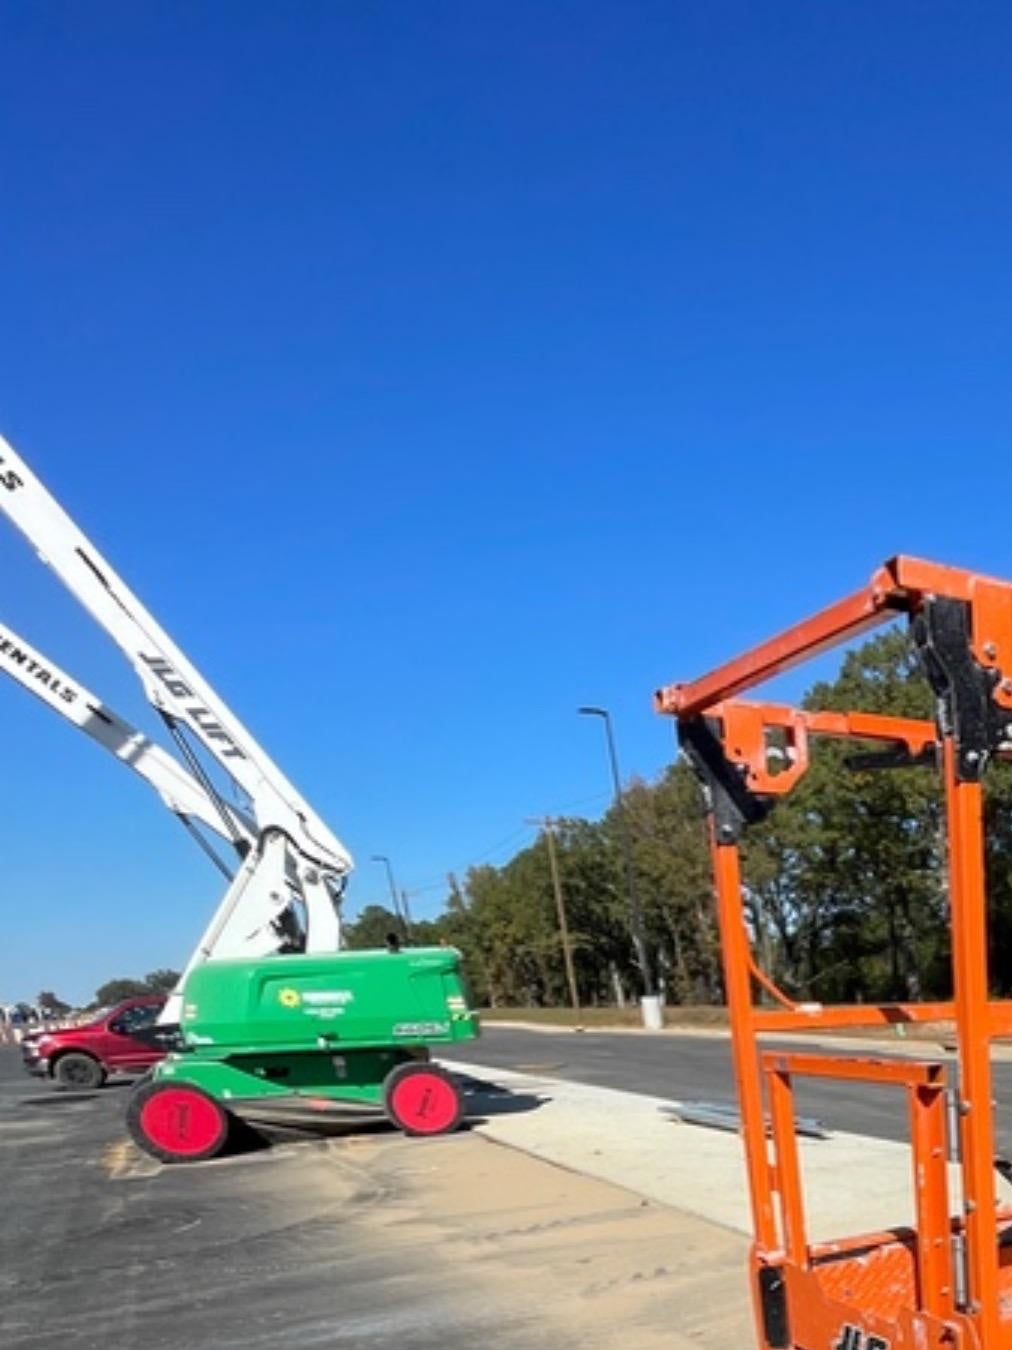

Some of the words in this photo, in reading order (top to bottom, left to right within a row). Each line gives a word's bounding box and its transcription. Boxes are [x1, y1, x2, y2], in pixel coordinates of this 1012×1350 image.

[0, 634, 78, 704] ENTALS
[138, 650, 194, 698] JLG
[184, 707, 247, 760] LIFT
